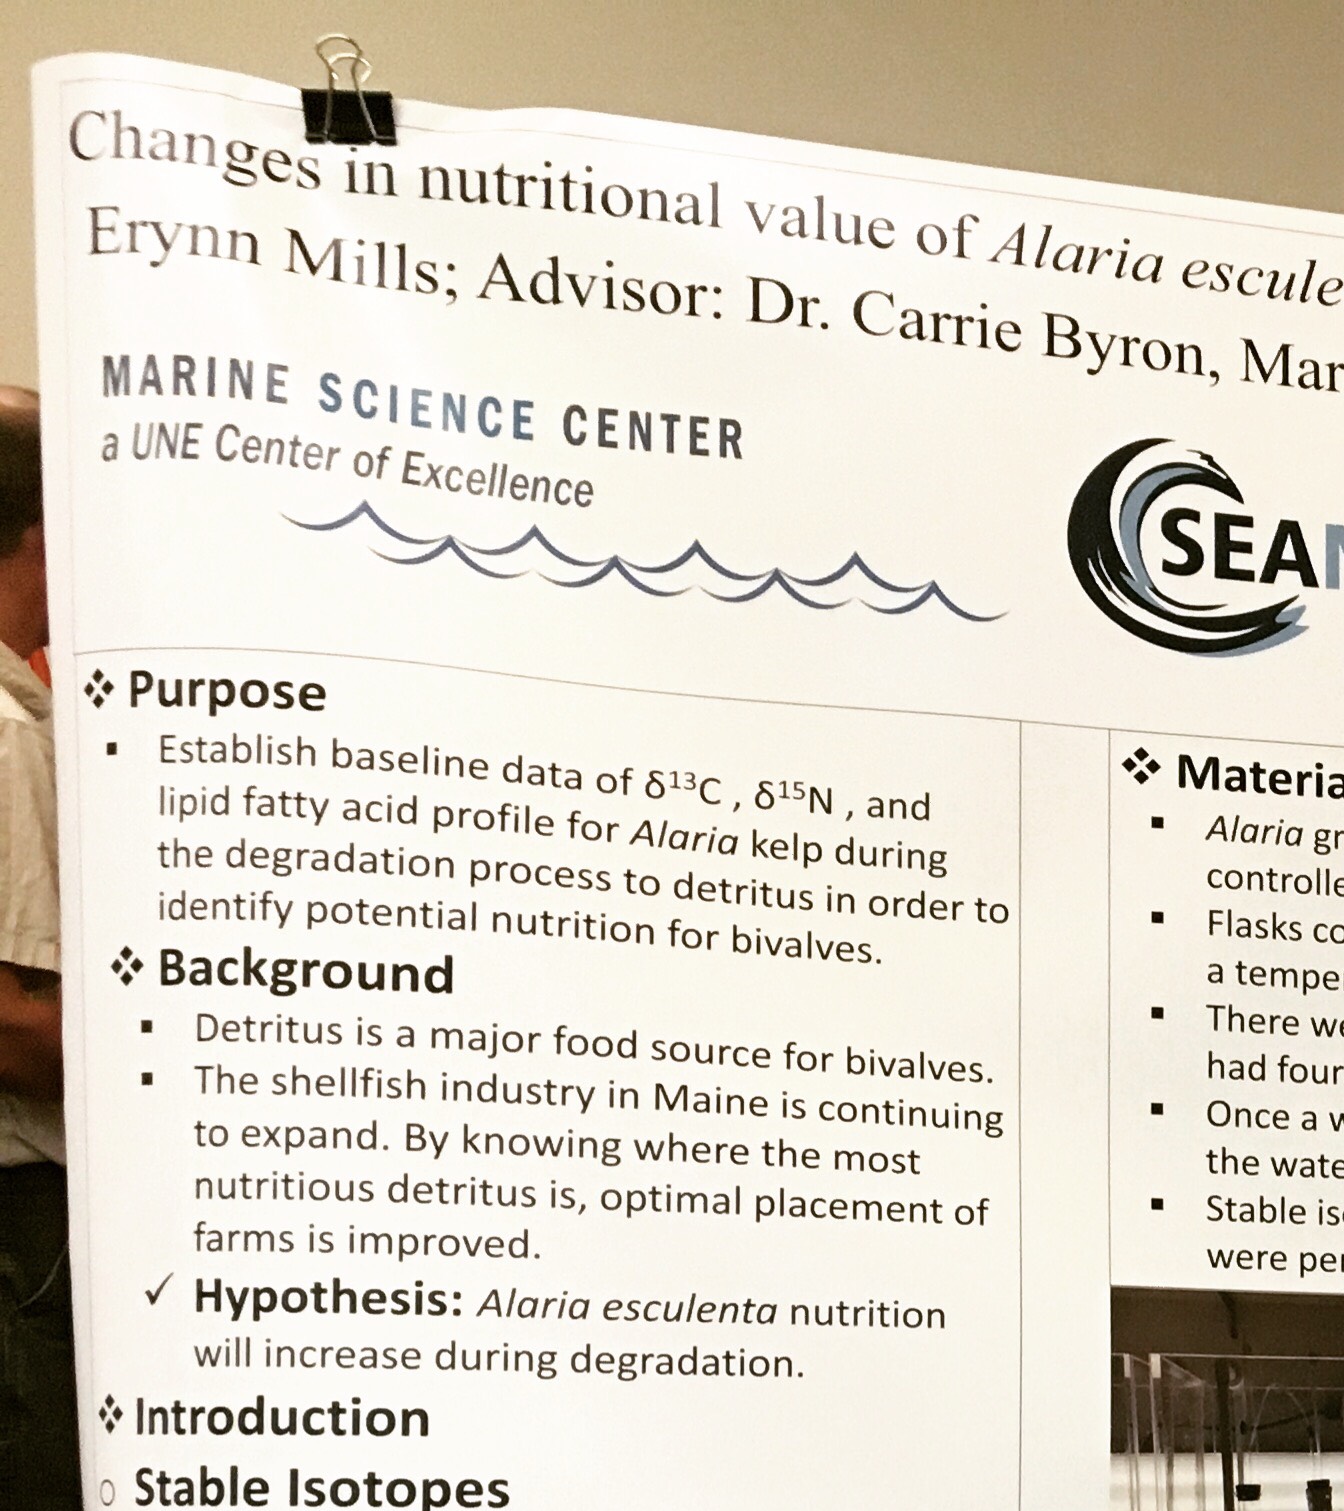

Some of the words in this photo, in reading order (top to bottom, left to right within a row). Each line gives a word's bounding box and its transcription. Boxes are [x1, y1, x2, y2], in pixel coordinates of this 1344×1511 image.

[68, 108, 322, 189] Changes
[344, 146, 398, 197] in
[419, 161, 720, 228] nutritional
[746, 195, 895, 249] value
[917, 214, 979, 259] of
[988, 223, 1163, 284] Alaria
[88, 206, 261, 268] Erynn
[285, 228, 457, 305] Mills;
[477, 253, 722, 319] Advisor:
[747, 276, 828, 330] Dr.
[853, 290, 1021, 352] Carrie
[1042, 312, 1220, 387] Byron,
[103, 354, 288, 404] MARINE
[319, 372, 535, 441] SCIENCE
[563, 404, 742, 459] CENTER
[101, 433, 118, 462] a
[131, 422, 203, 461] UNE
[216, 423, 340, 471] Center
[353, 445, 394, 479] of
[401, 450, 595, 508] Excellence
[130, 670, 326, 717] Purpose
[1205, 815, 1303, 847] Alaria
[160, 946, 453, 997] Background
[197, 1013, 342, 1045] Detritus
[357, 1017, 382, 1046] is
[396, 1026, 414, 1048] a
[431, 1023, 541, 1059] major
[553, 1025, 637, 1059] food
[651, 1040, 771, 1068] source
[783, 1042, 834, 1072] for
[847, 1046, 993, 1084] bivalves.
[196, 1277, 461, 1322] Hypothesis:
[476, 1288, 590, 1320] Alaria
[603, 1293, 777, 1325] esculenta
[791, 1299, 945, 1329] nutrition
[136, 1395, 429, 1437] Introduction
[135, 1465, 269, 1507] Stable
